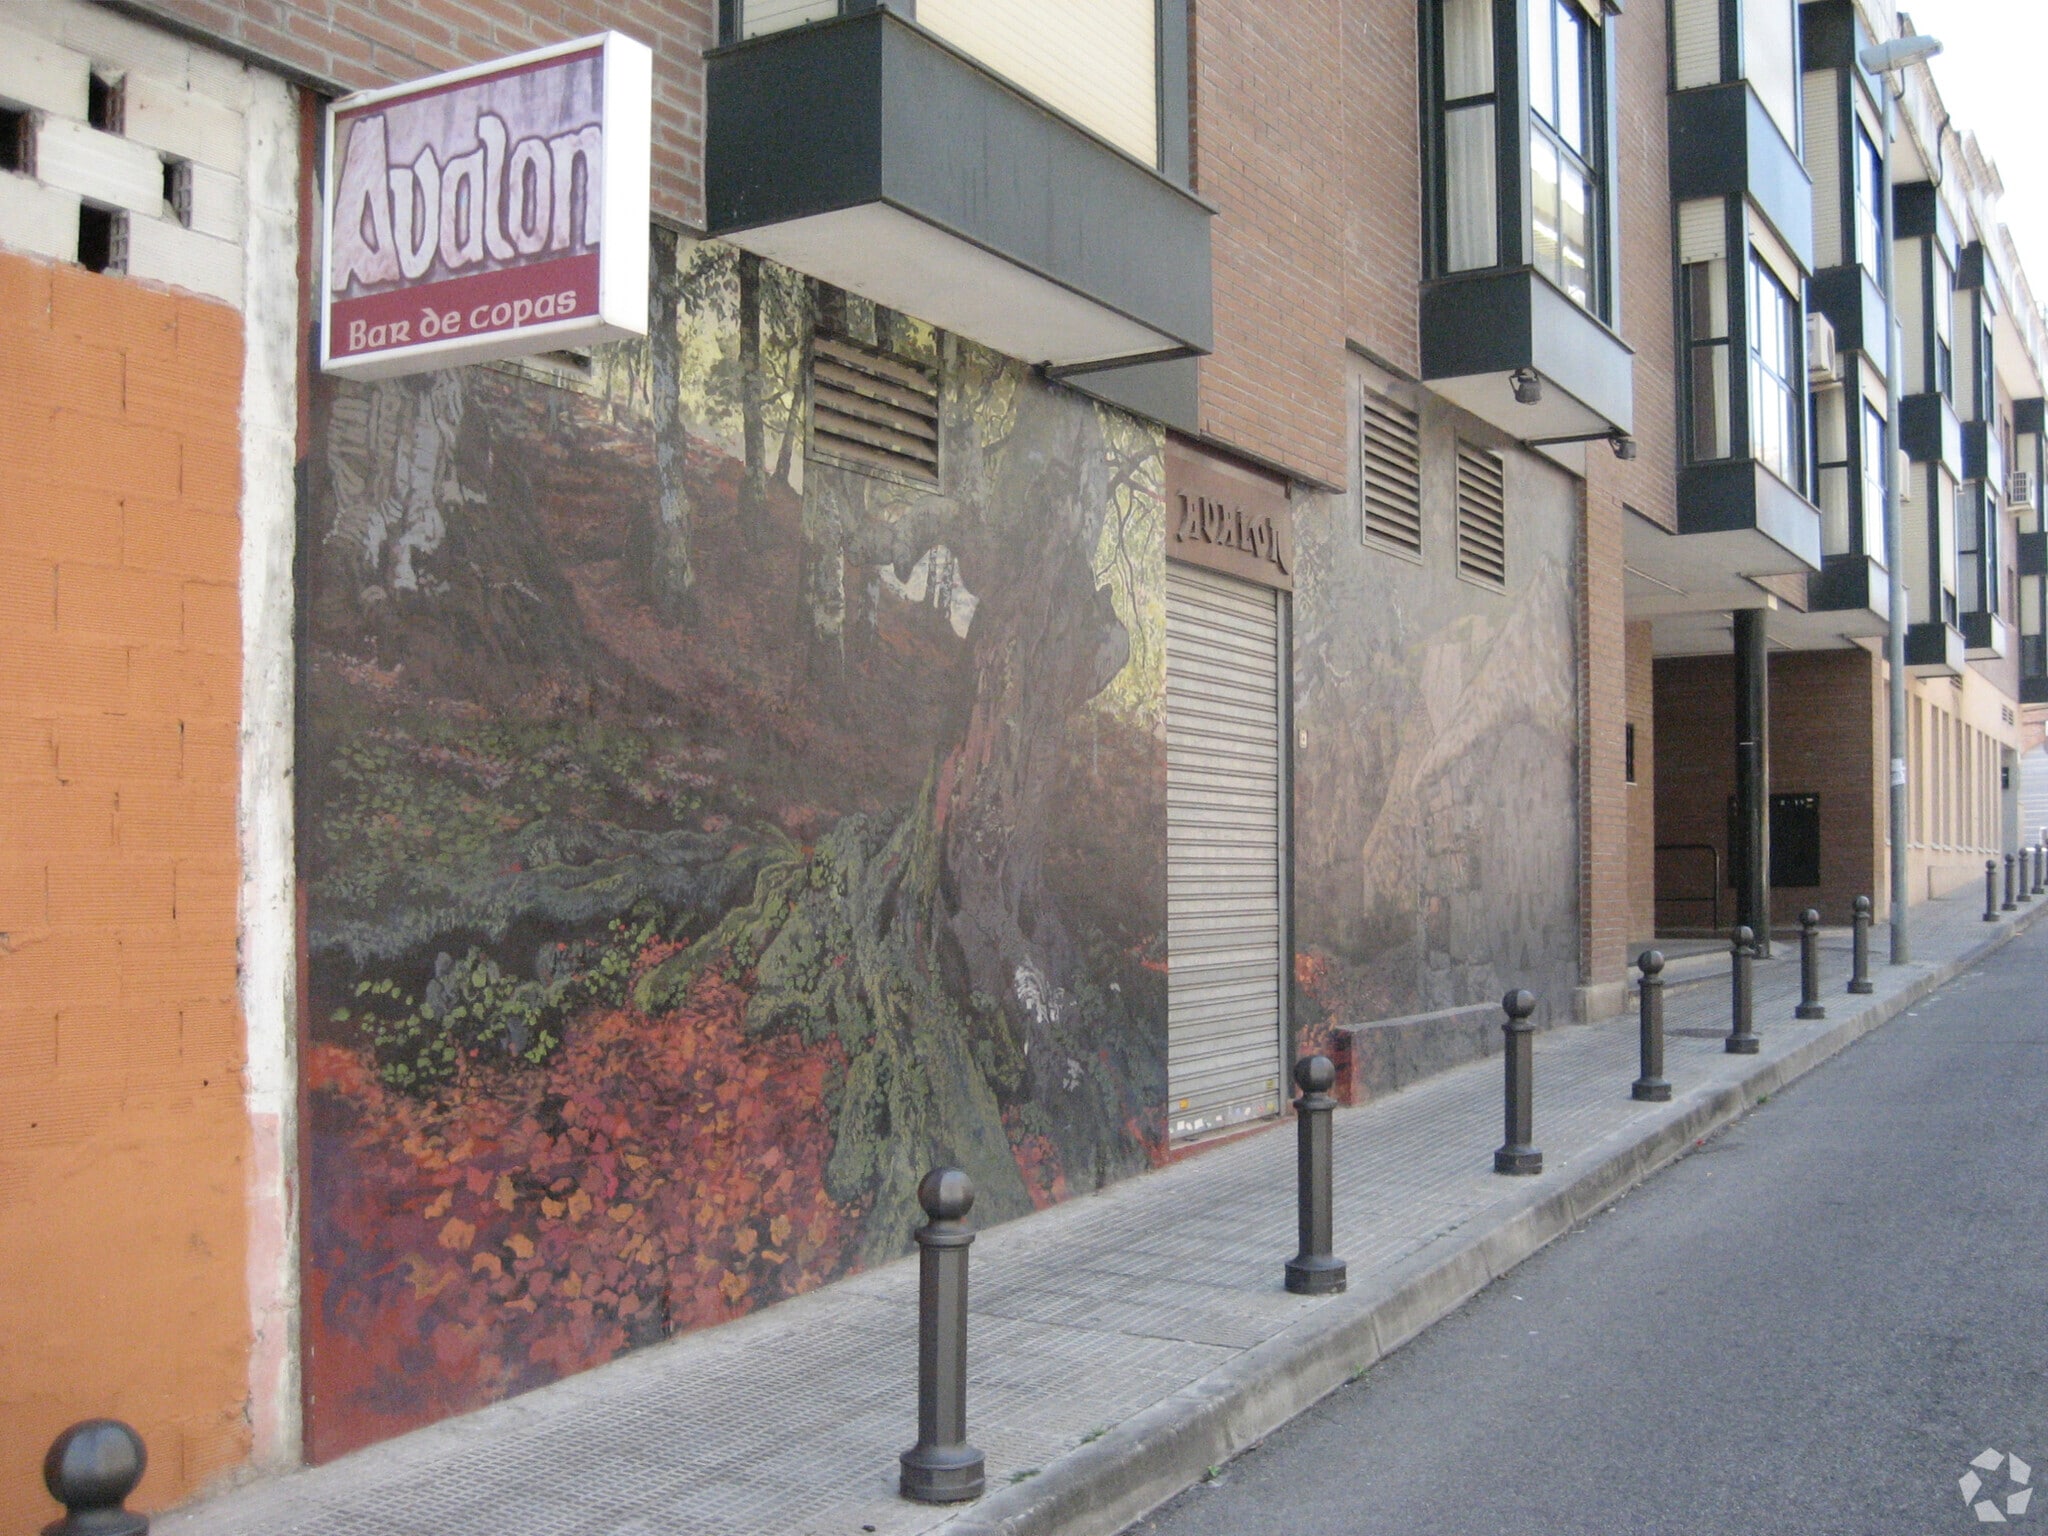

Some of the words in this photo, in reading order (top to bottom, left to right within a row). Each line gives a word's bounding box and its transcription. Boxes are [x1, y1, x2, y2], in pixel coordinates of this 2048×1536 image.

[332, 112, 602, 292] Avalon
[419, 307, 462, 338] de
[469, 289, 577, 330] copas
